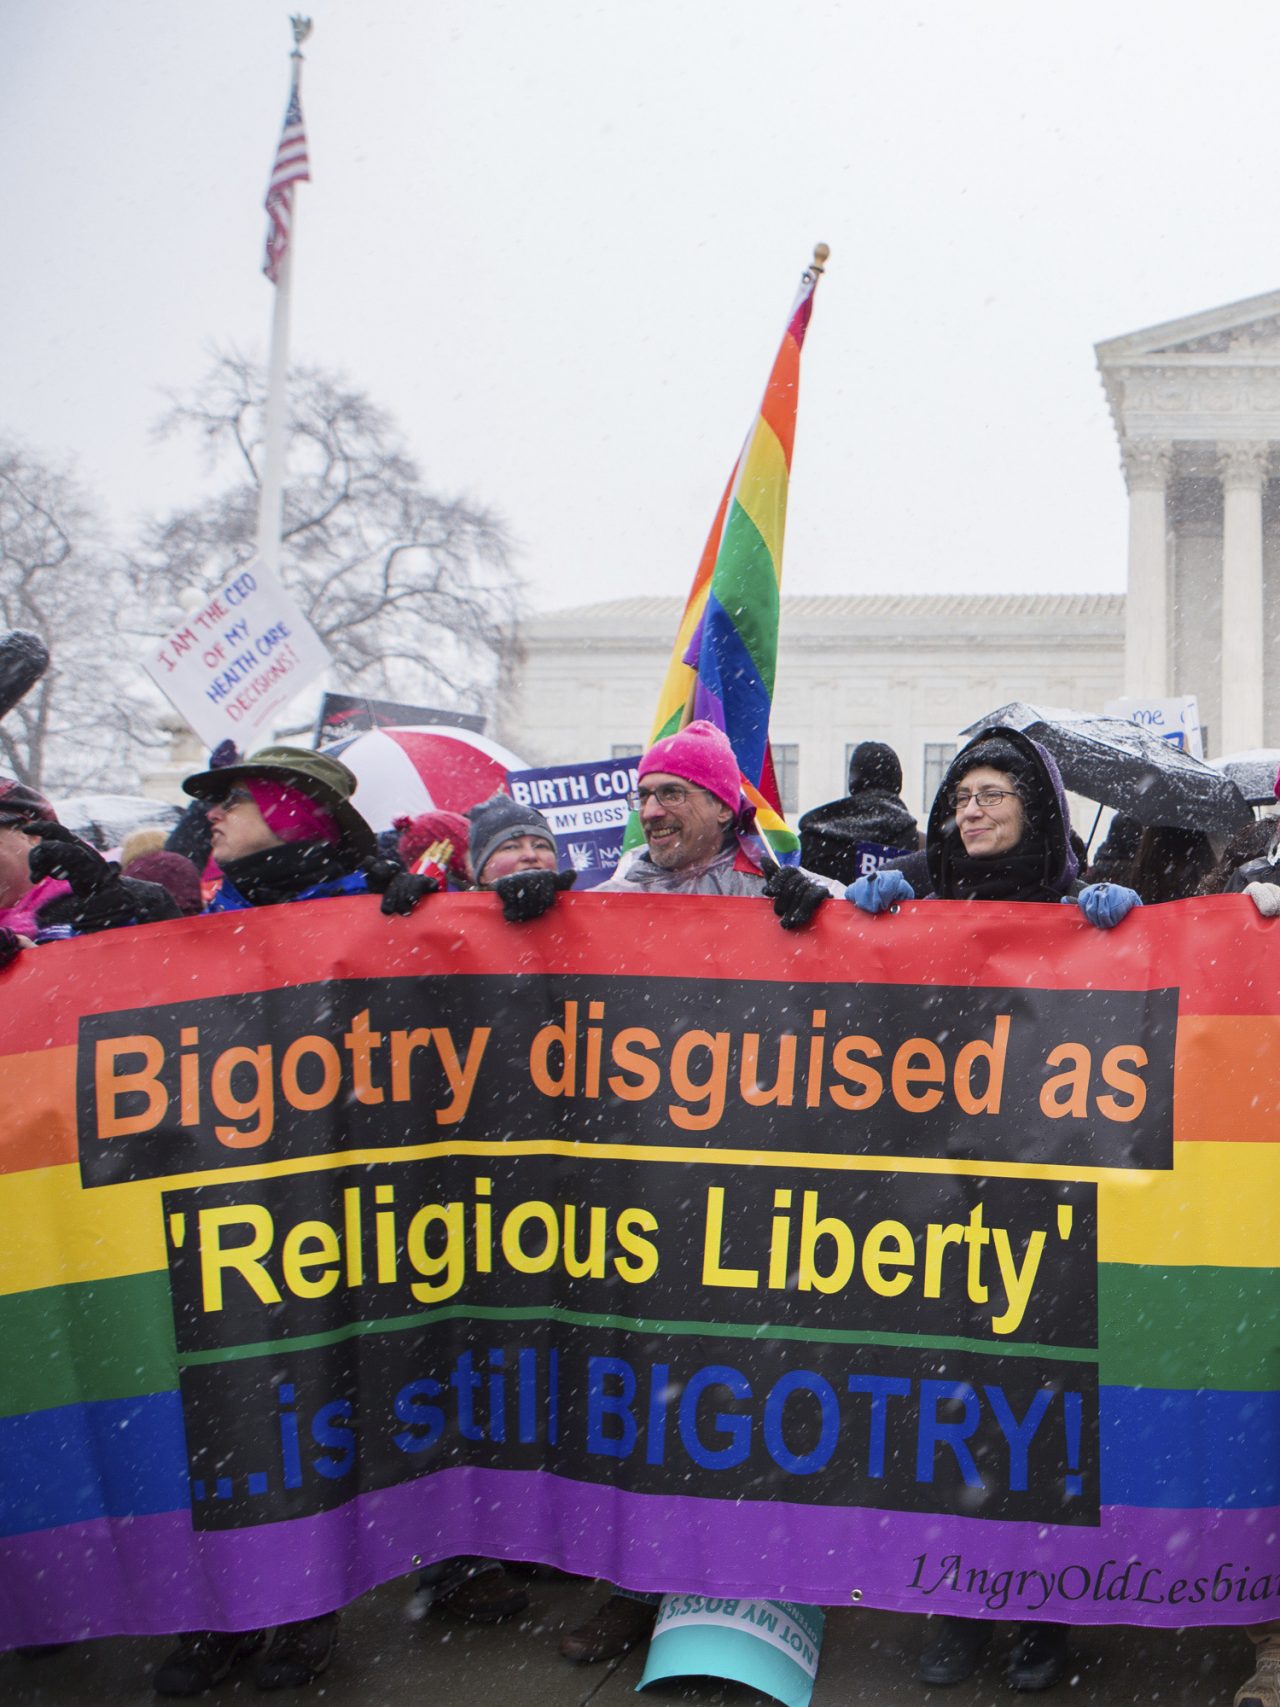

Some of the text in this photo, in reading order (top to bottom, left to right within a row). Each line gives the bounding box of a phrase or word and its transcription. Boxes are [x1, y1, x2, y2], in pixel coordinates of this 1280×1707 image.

[157, 573, 257, 672] I AM THE CEO
[203, 618, 250, 668] OF MY
[205, 621, 291, 704] HEALTH CARE
[226, 643, 300, 722] DECISIONS!
[1132, 710, 1165, 725] me
[511, 775, 589, 805] BIRTH
[556, 813, 577, 828] MY
[599, 845, 624, 859] NA
[95, 1001, 1148, 1149] Bigotry disguised as
[169, 1177, 1073, 1334] 'Religious Liberty'
[194, 1348, 1083, 1499] ...is still BIGOTRY!
[741, 1603, 779, 1633] MY
[779, 1625, 814, 1666] NOT
